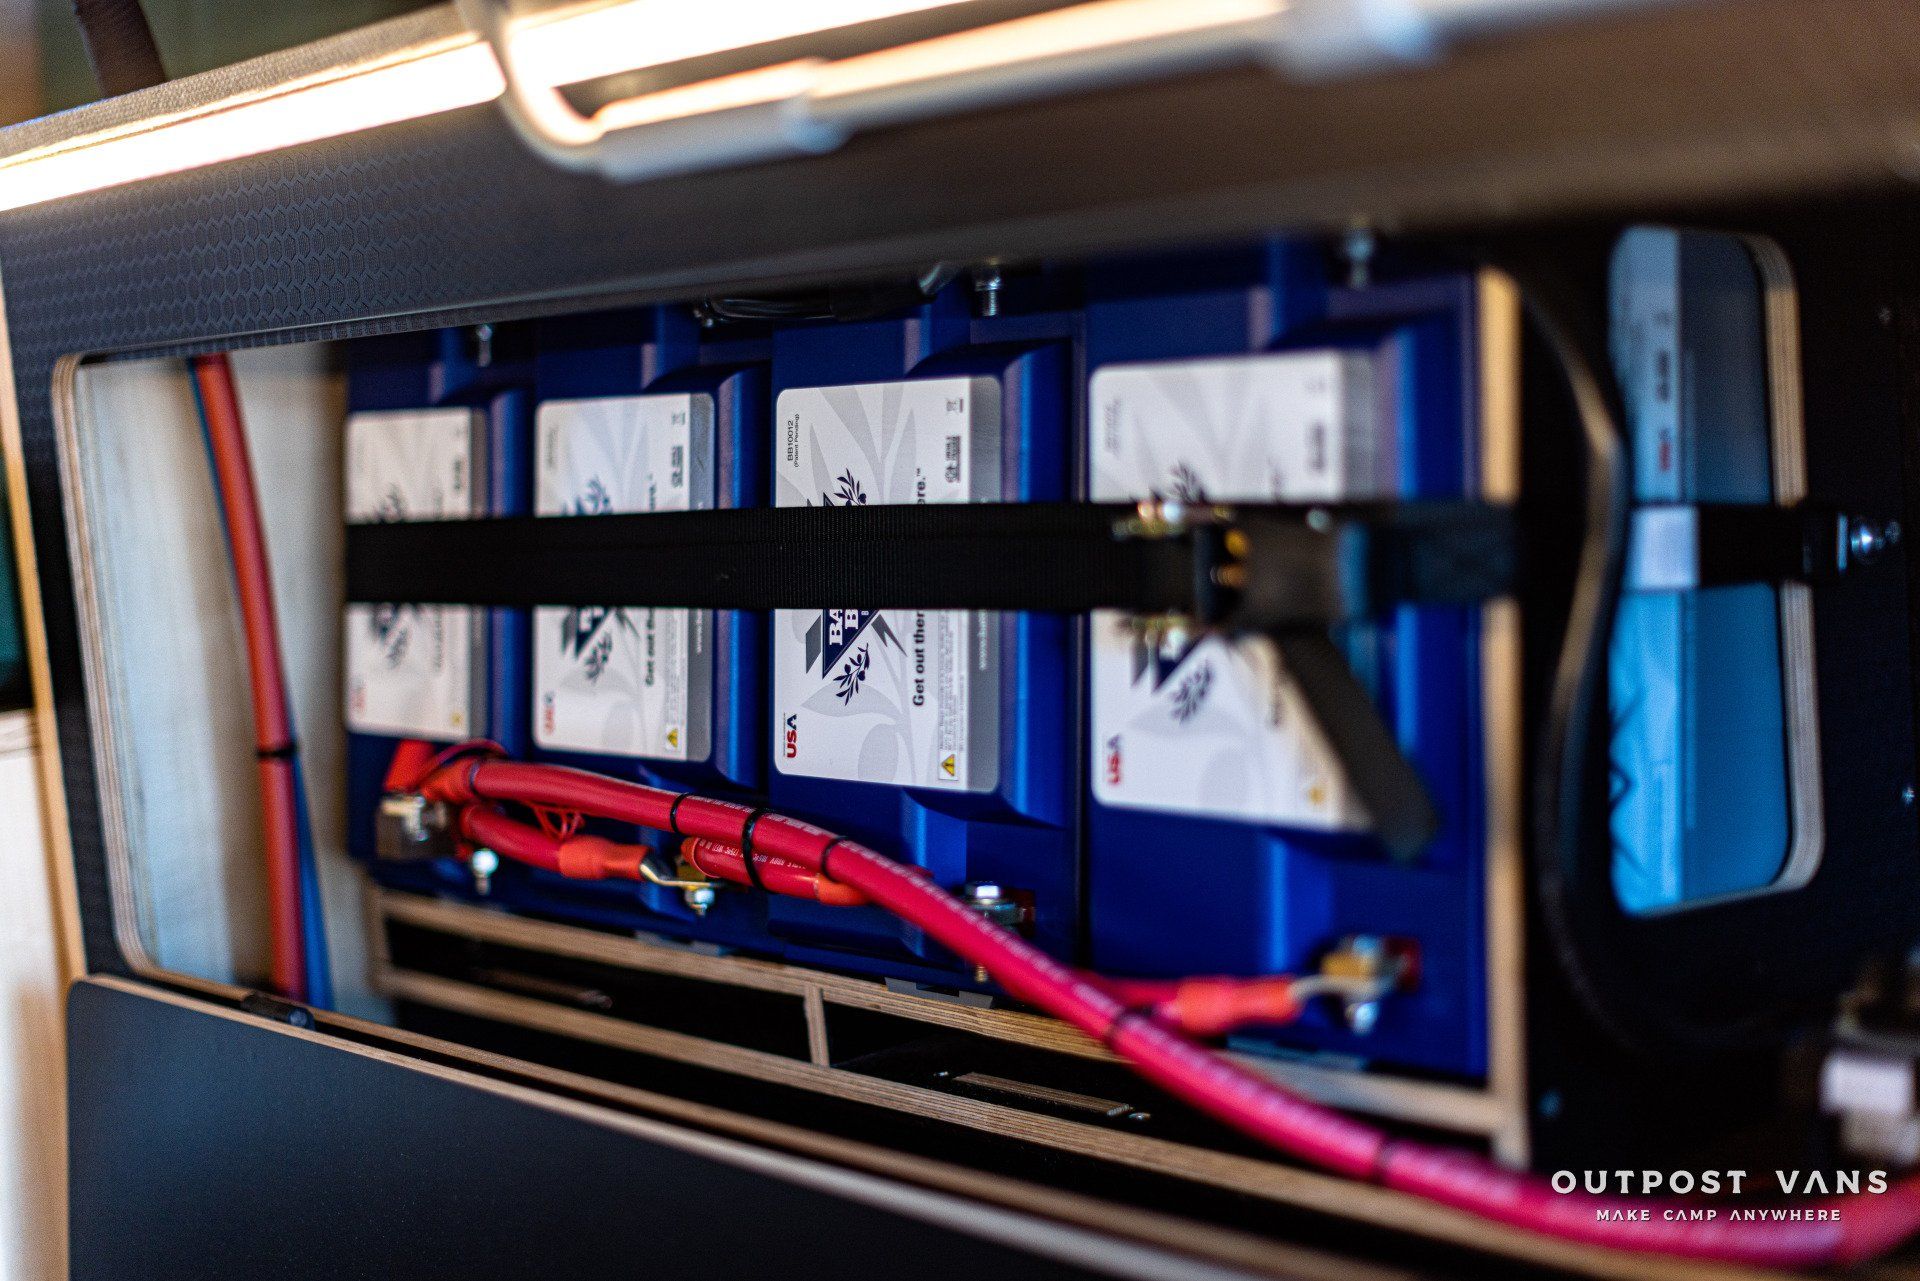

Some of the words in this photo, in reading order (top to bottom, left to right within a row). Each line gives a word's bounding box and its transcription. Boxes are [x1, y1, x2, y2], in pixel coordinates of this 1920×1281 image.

[913, 611, 925, 646] ther
[914, 649, 925, 674] out
[912, 679, 925, 707] Get
[786, 713, 797, 758] USA
